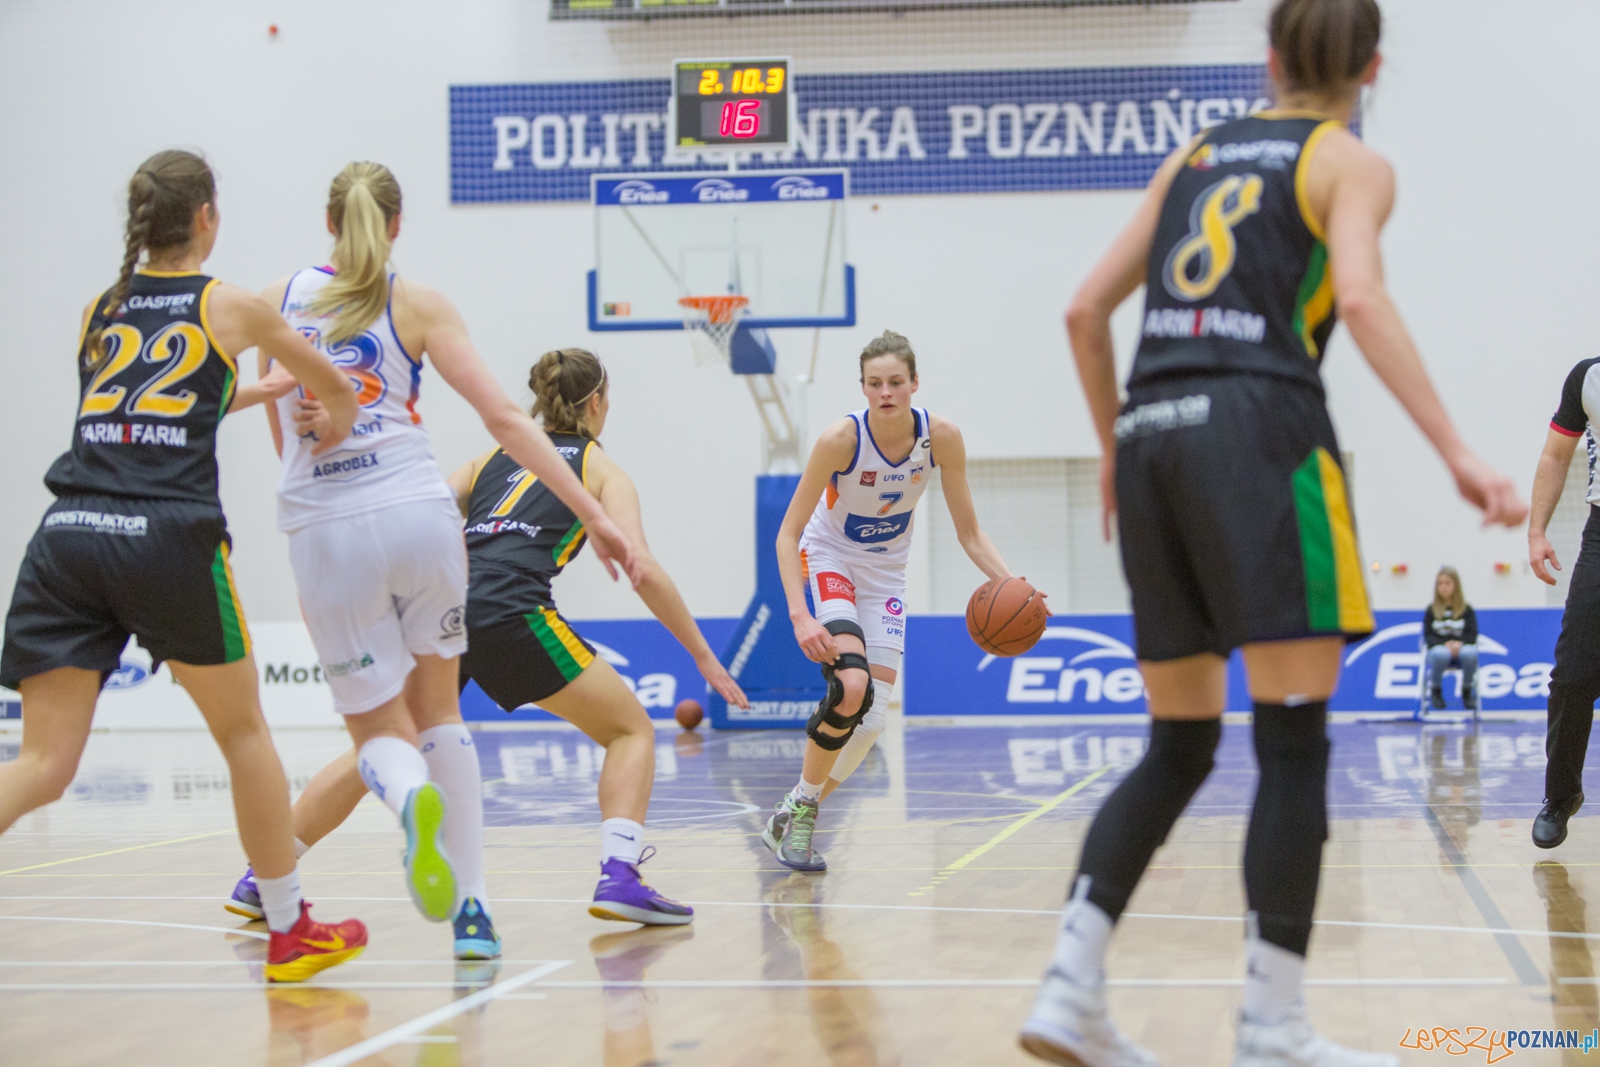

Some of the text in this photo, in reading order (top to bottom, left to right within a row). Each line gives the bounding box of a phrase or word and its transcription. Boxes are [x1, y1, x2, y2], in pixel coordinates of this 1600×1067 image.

[492, 88, 1270, 171] POLITNIKA POZNAŃS
[720, 100, 760, 138] 16
[619, 187, 670, 204] Enea
[698, 186, 749, 202] Enea
[778, 184, 829, 201] Enea
[1162, 172, 1264, 302] 8
[129, 293, 196, 310] GASTER
[1144, 307, 1266, 343] ARM2FARM
[77, 320, 210, 420] 22
[313, 452, 379, 479] AGROBEX
[877, 491, 904, 516] 7
[860, 523, 901, 538] Enea
[265, 662, 328, 684] Mot
[1006, 656, 1150, 703] Ene
